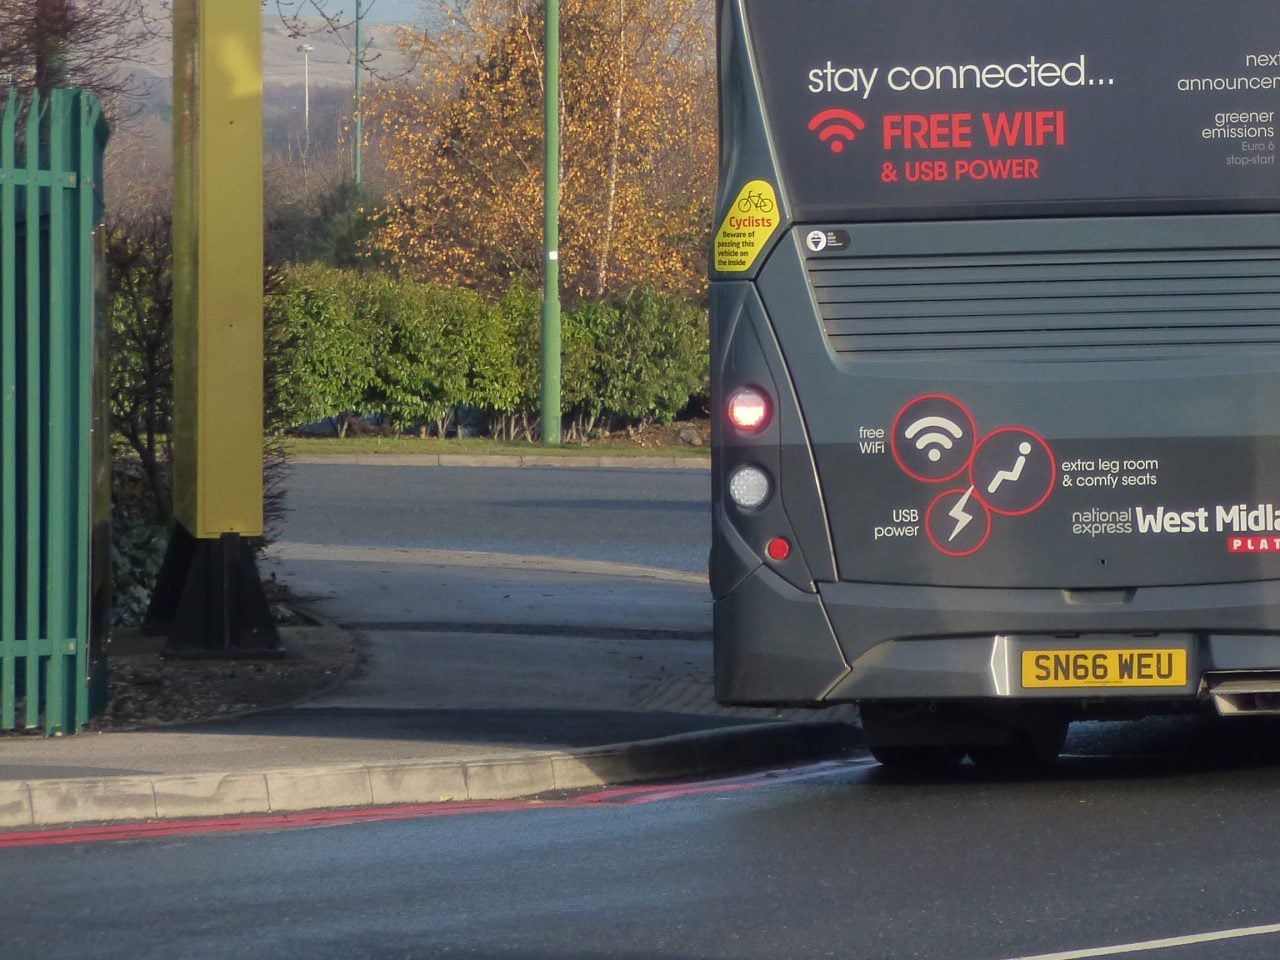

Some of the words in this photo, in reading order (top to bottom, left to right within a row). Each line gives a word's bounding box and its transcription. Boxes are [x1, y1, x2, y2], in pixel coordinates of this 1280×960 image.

[807, 61, 879, 100] stay
[887, 54, 1114, 91] connected...
[1214, 111, 1275, 127] greener
[882, 112, 972, 150] FREE
[982, 110, 1065, 147] WIFI
[1201, 124, 1275, 140] emissions
[1241, 141, 1263, 152] Euro
[1268, 141, 1275, 151] 6
[1226, 154, 1275, 166] stop-start
[880, 161, 898, 182] &
[905, 160, 948, 182] USB
[955, 158, 1039, 180] POWER
[729, 216, 772, 230] Cyclists
[747, 230, 755, 238] of
[717, 241, 740, 249] passing
[717, 249, 739, 257] vehicle
[859, 426, 885, 439] free
[859, 442, 885, 454] WiFi
[1061, 460, 1095, 472] extra
[1098, 458, 1120, 474] leg
[1123, 458, 1159, 470] room
[1062, 475, 1073, 487] &
[1075, 474, 1119, 488] comfy
[1121, 474, 1157, 486] seats
[892, 509, 919, 523] USB
[1072, 507, 1132, 523] national
[1135, 506, 1209, 534] West
[874, 525, 920, 540] power
[1072, 522, 1133, 538] express
[1034, 653, 1109, 681] SN66
[1117, 652, 1173, 680] WEU
